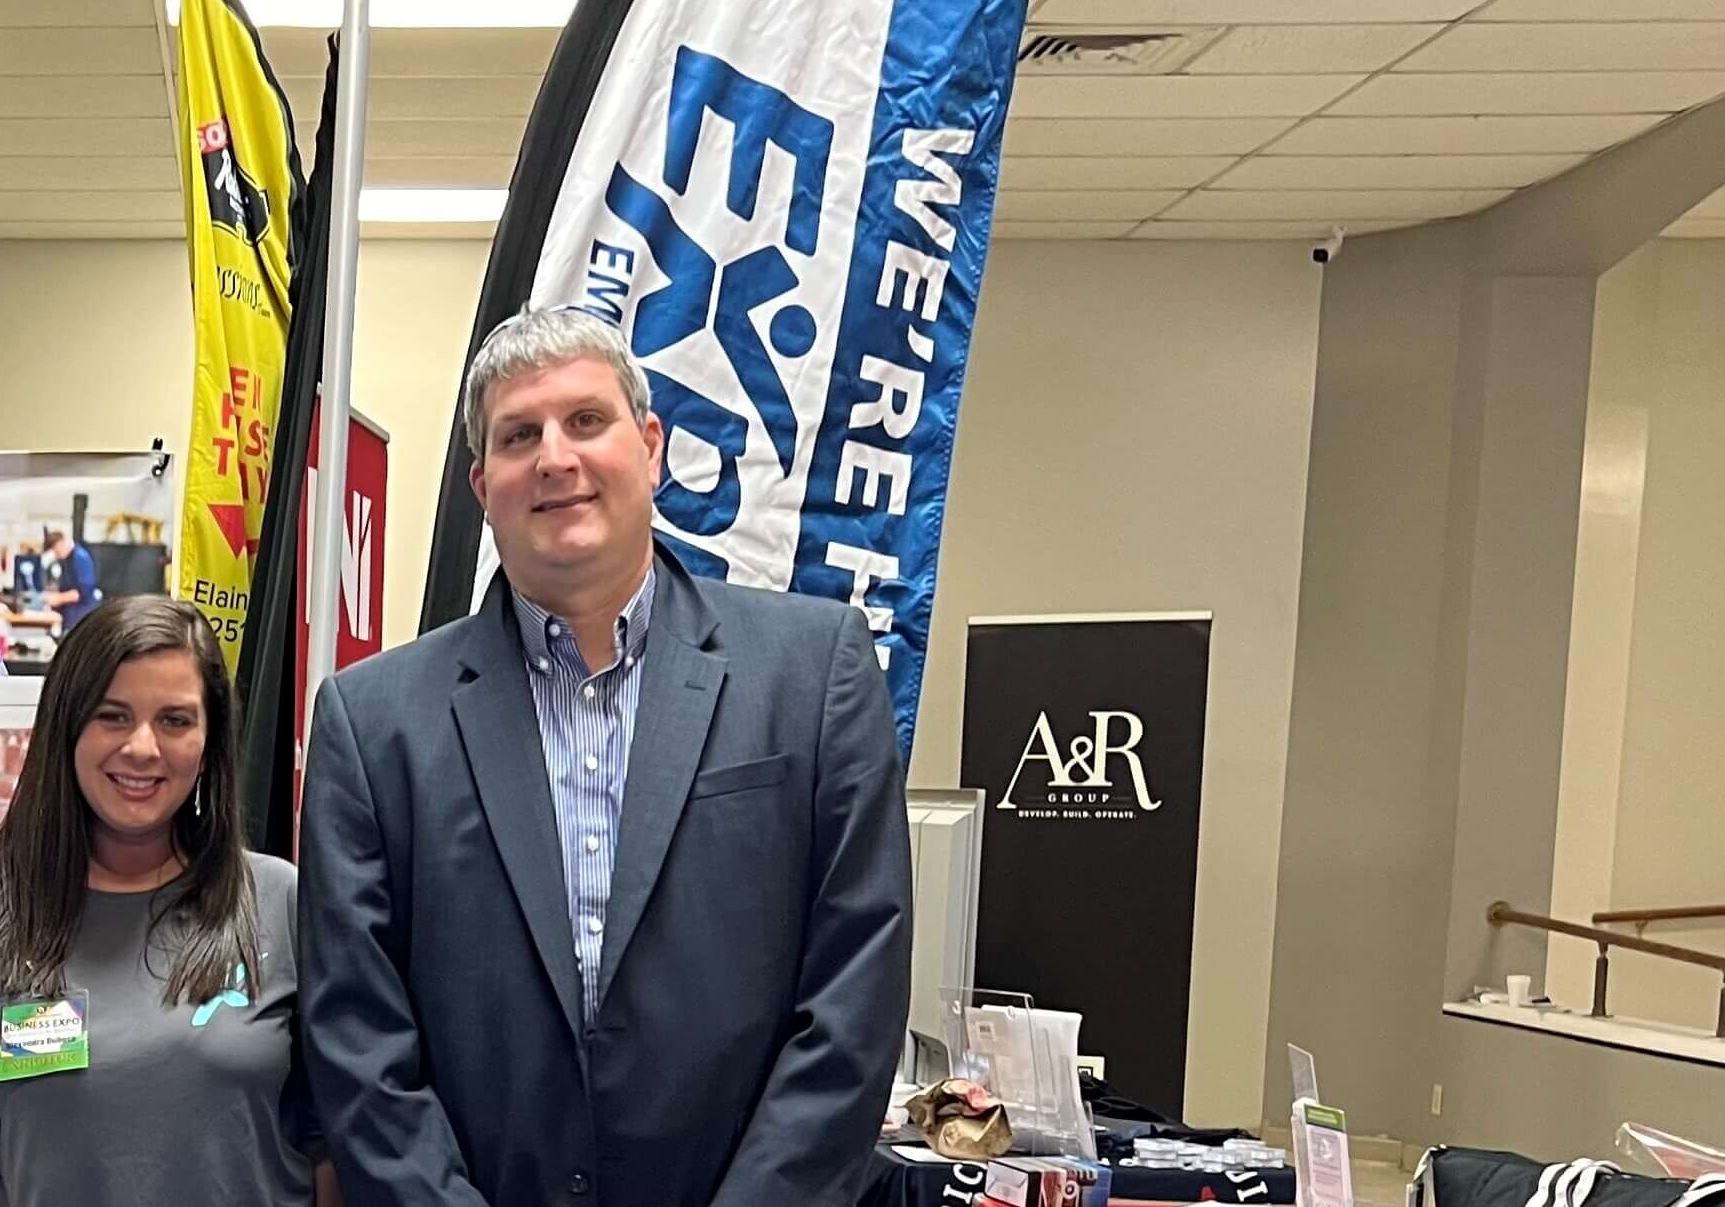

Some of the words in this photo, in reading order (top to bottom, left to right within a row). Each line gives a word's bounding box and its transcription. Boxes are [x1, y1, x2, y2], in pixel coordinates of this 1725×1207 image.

[837, 129, 975, 516] WE'RE
[996, 710, 1162, 811] A&R
[1047, 793, 1110, 803] GROUP
